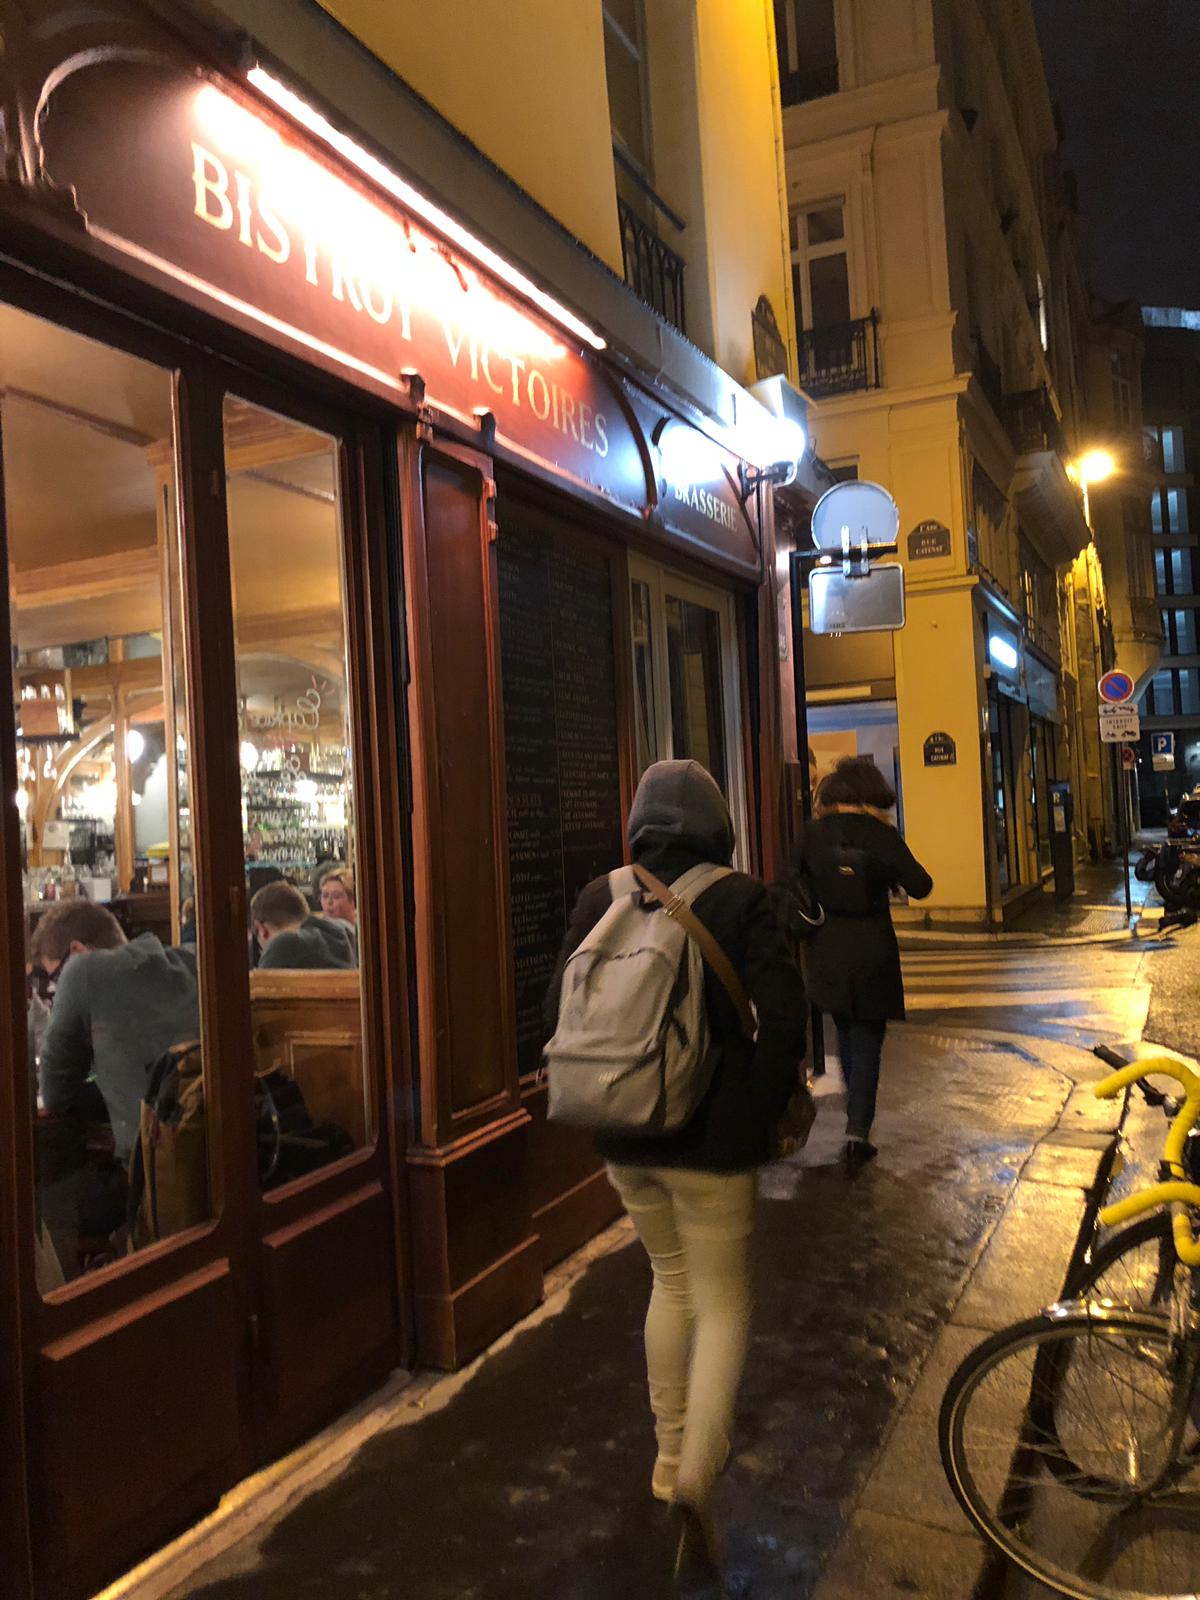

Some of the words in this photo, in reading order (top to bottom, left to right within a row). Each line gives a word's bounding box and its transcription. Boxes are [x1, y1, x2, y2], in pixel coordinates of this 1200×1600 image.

[190, 139, 413, 341] BISTROT
[441, 316, 609, 458] VICTOIRES
[674, 480, 738, 532] BRASSERIE
[1157, 736, 1167, 752] P
